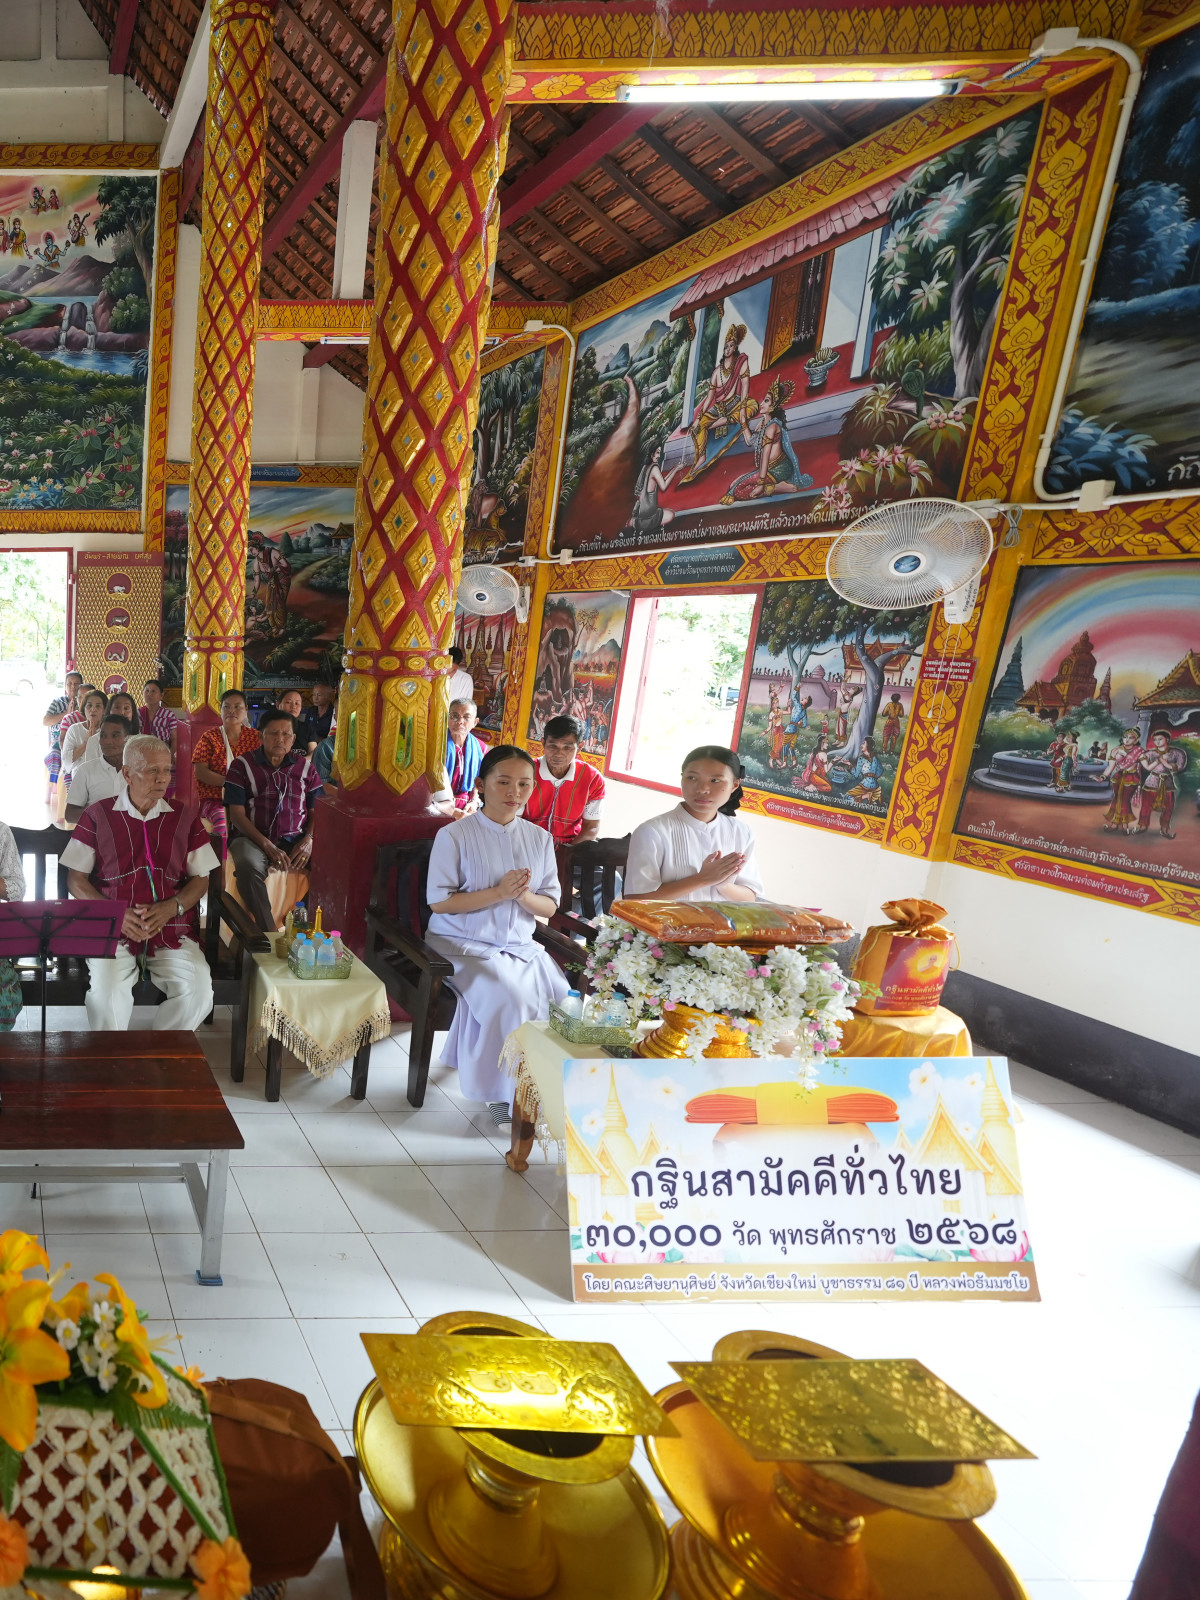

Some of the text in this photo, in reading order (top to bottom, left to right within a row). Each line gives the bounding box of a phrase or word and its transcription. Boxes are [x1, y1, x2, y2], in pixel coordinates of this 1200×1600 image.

[630, 1144, 962, 1210] กฐินสามัคคีทั่วไทย
[586, 1217, 1018, 1255] ๓๐,๐๐๐ วัด พุทธศักราช ๒๕๖๘
[585, 1273, 1028, 1295] โดย คณะศิษยานุศิษย์ จังหวัดเชียงใหม่ บูชาธรรม ๘๑ ปี หลวงพ่อธัมมชโย
